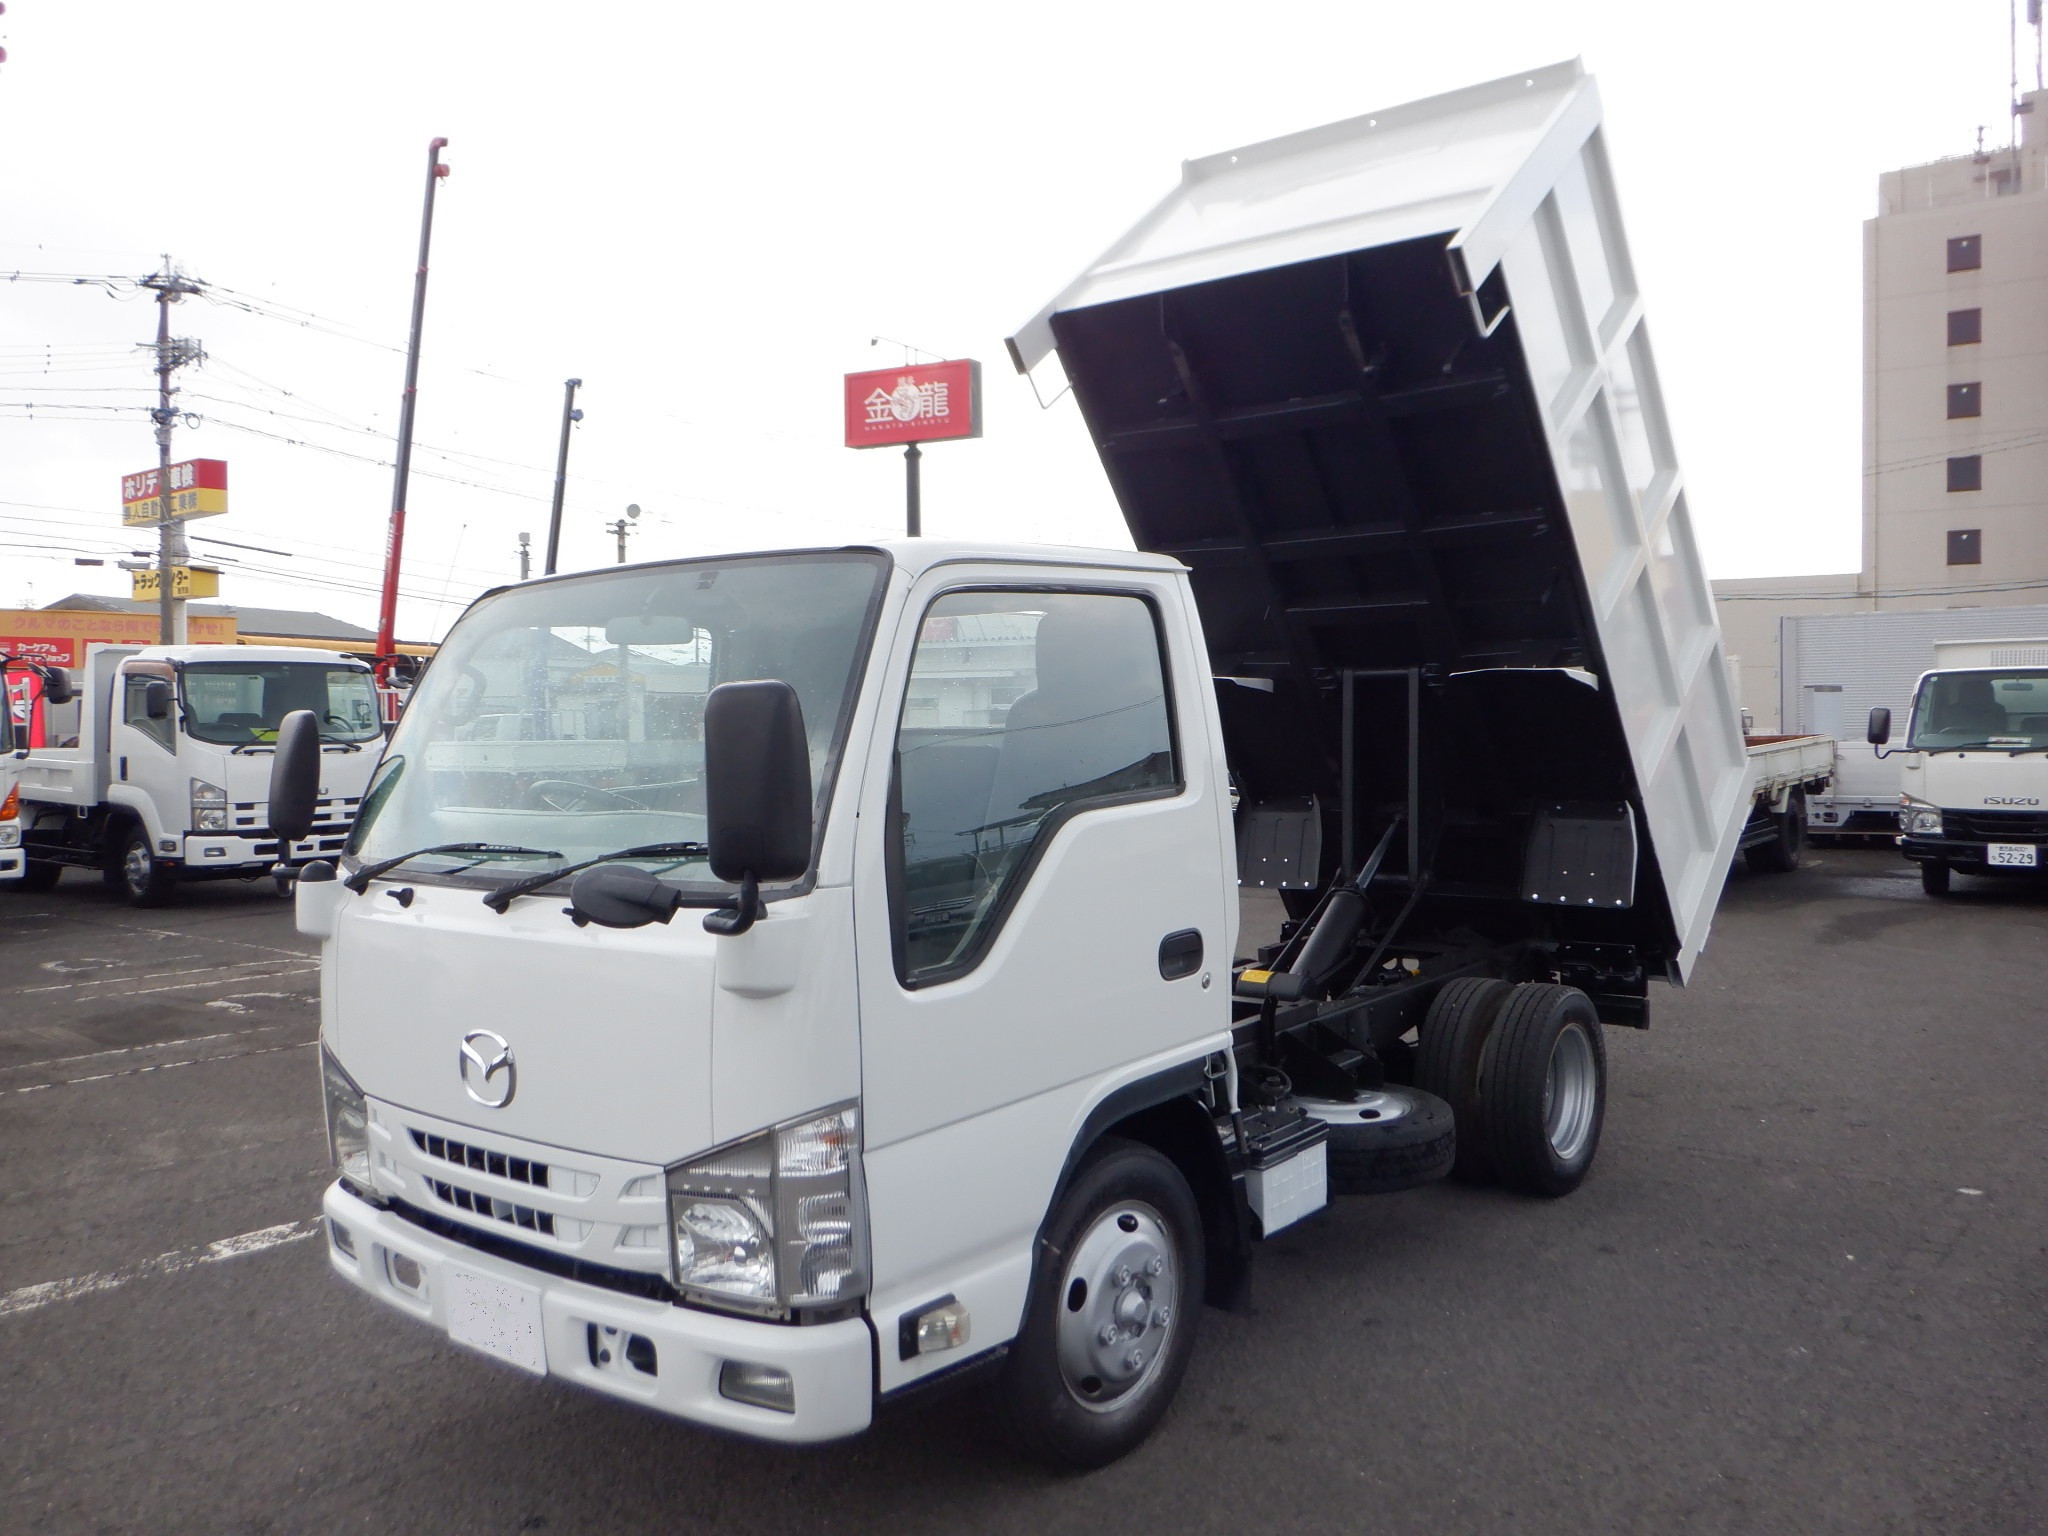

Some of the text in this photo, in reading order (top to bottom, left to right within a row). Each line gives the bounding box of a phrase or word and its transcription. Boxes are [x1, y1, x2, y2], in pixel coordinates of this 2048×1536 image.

[863, 381, 950, 423] 金龍
[124, 463, 194, 499] ホリデ車検
[1983, 796, 2040, 806] ISUZU
[1998, 852, 2034, 864] 52-29
